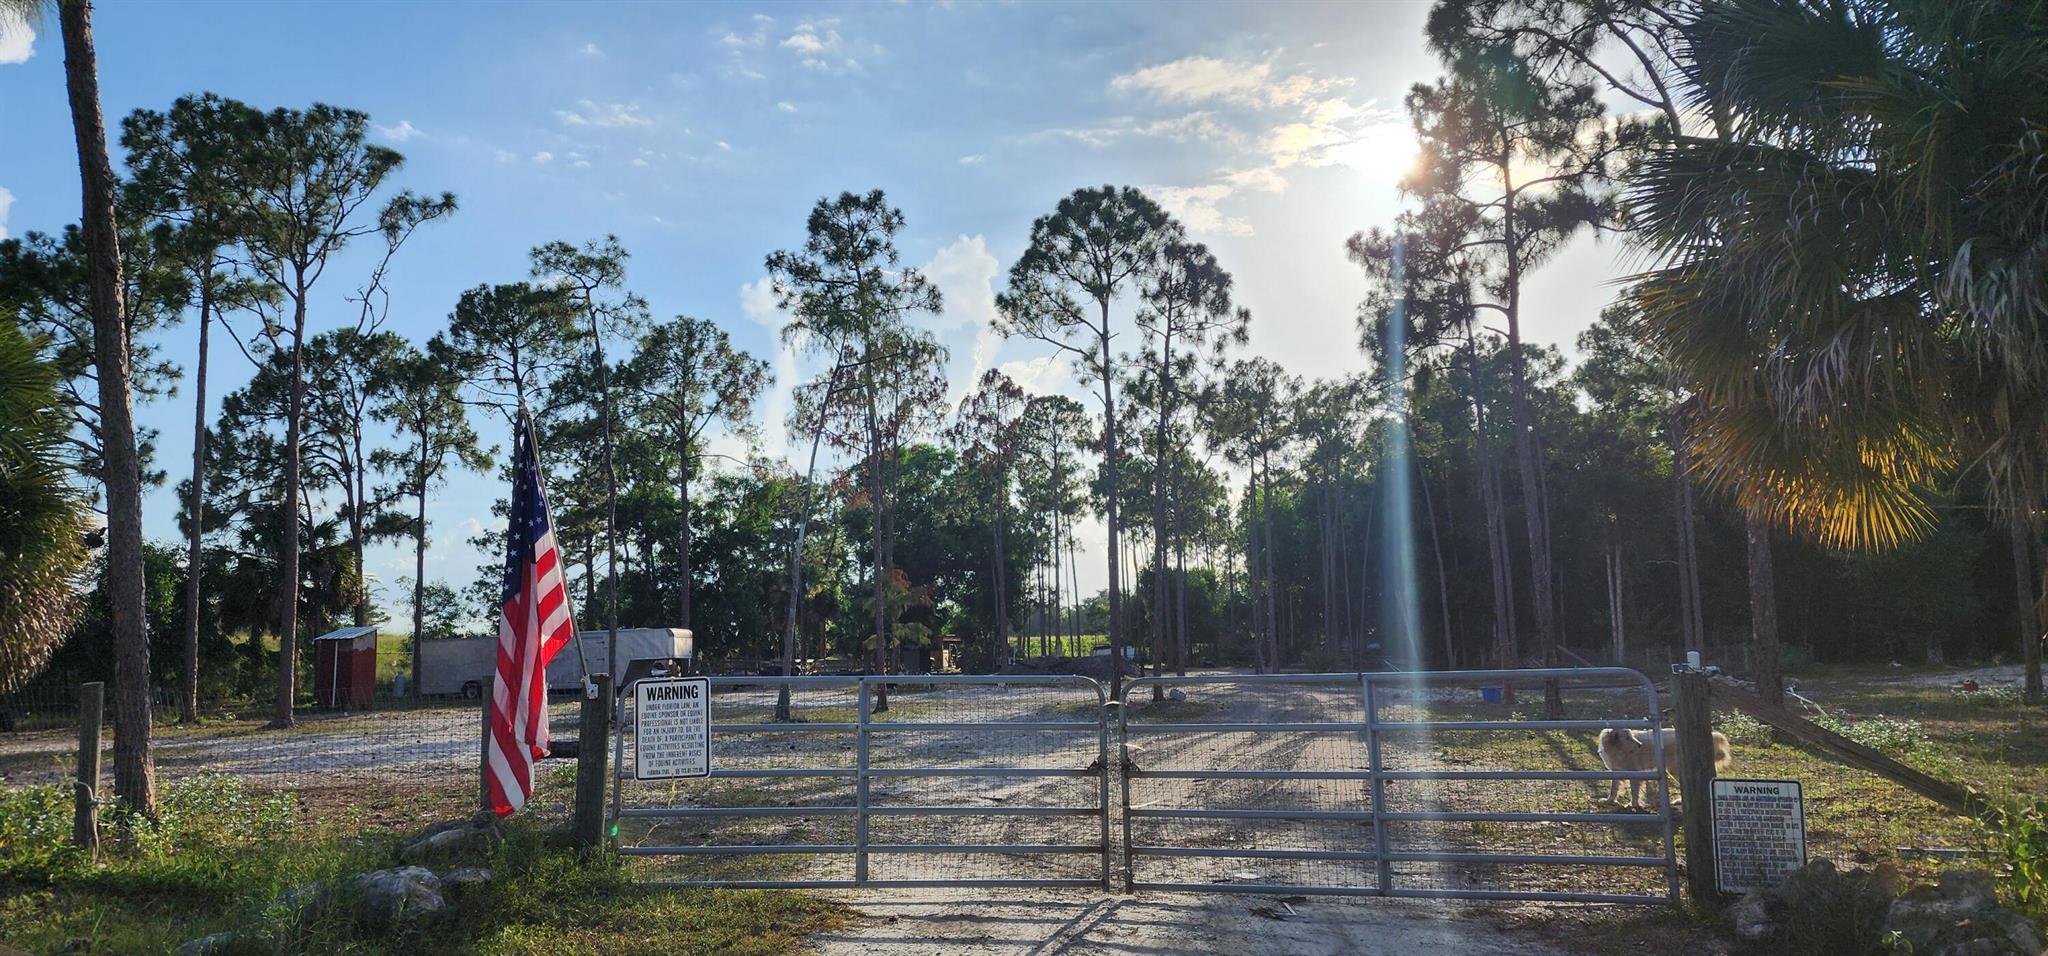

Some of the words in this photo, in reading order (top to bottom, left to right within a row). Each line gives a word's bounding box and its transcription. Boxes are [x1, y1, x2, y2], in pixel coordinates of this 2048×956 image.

[646, 684, 698, 701] WARNING
[641, 719, 672, 727] PROFESSIONAL
[1734, 786, 1780, 794] WARNING
